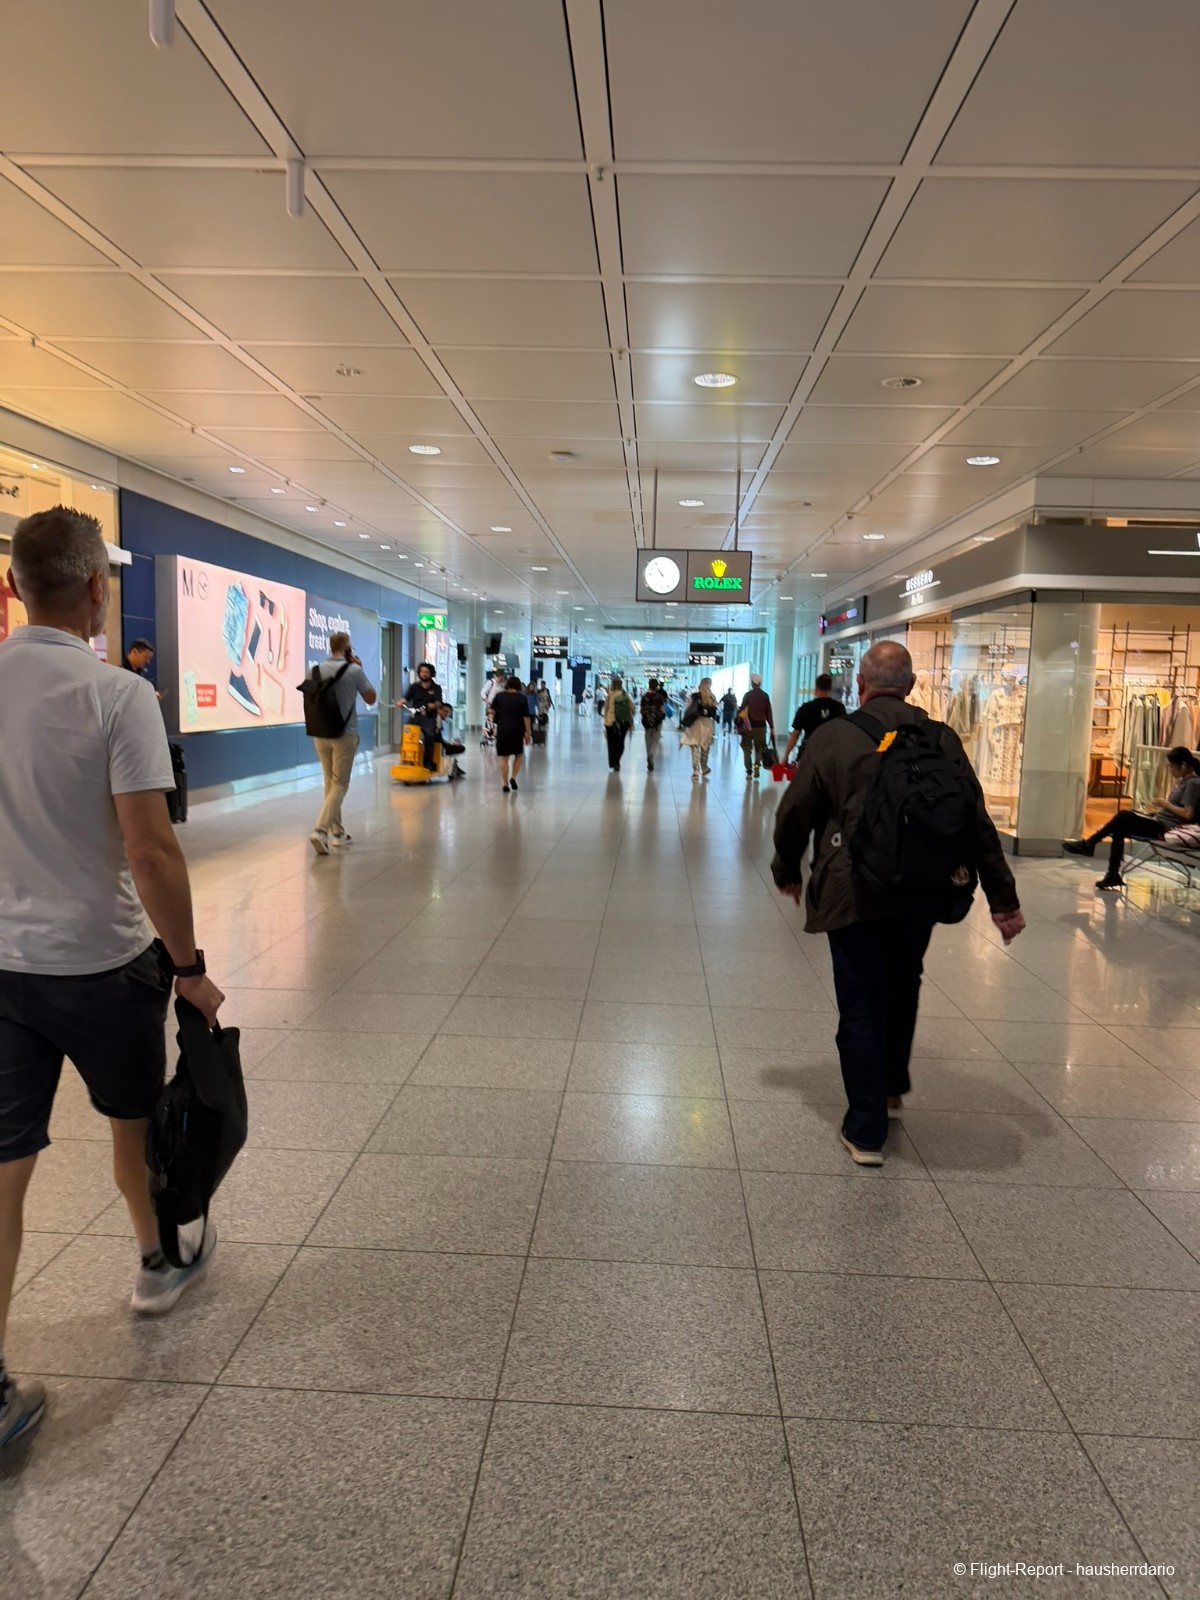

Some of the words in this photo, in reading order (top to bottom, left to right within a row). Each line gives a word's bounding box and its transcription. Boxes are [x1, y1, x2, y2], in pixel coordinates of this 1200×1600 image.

[693, 576, 743, 590] ROLEX
[308, 607, 328, 632] Shop,
[308, 631, 326, 650] treat
